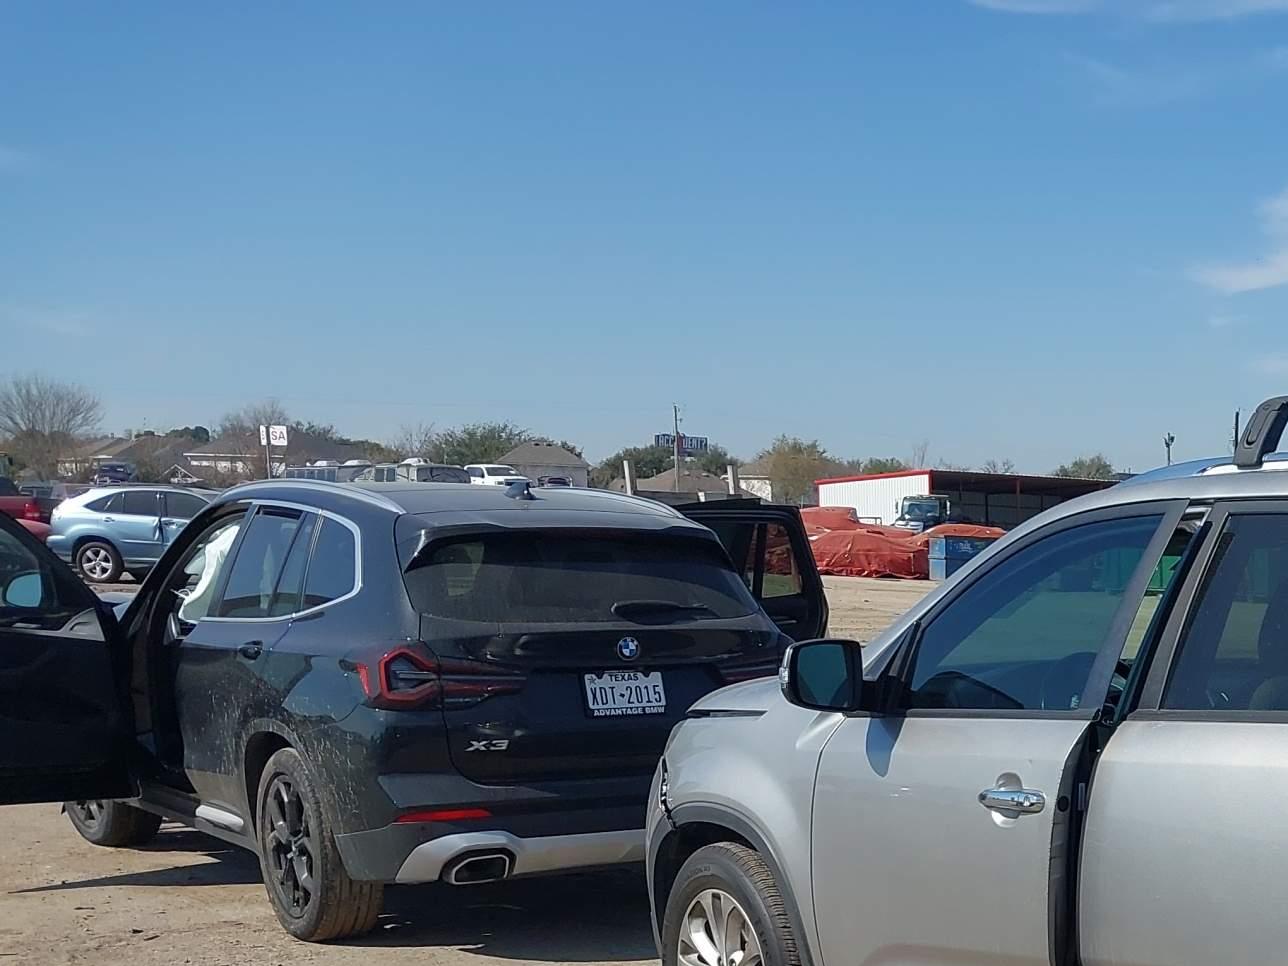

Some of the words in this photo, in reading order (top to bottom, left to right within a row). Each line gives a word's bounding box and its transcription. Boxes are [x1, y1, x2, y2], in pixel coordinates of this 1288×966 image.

[608, 673, 639, 682] TEXAS
[593, 707, 644, 717] ADVANTAGE
[465, 740, 509, 752] X3
